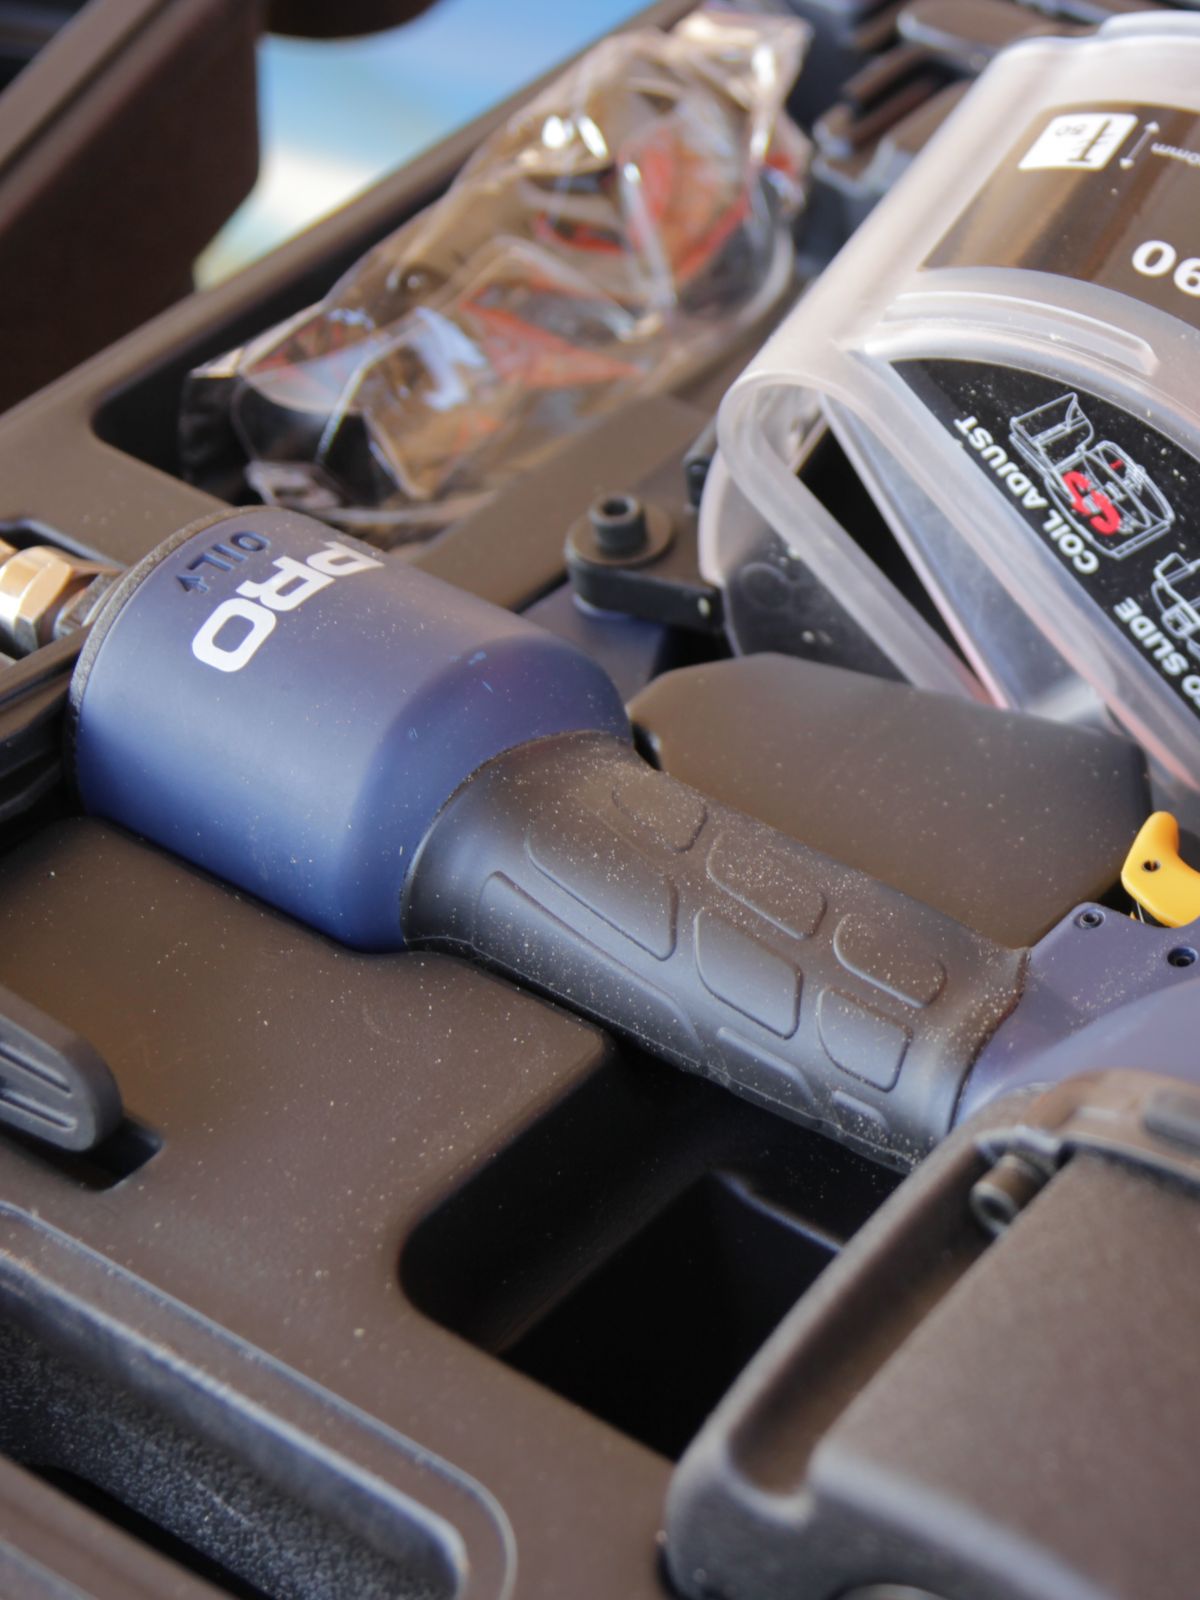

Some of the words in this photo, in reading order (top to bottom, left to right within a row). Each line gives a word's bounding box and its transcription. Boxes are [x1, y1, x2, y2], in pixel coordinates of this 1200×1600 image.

[953, 416, 1049, 510] ADJUST
[187, 530, 271, 573] OIL
[1043, 509, 1099, 574] COIL
[192, 541, 385, 673] PRO
[1113, 597, 1190, 676] SLIDE
